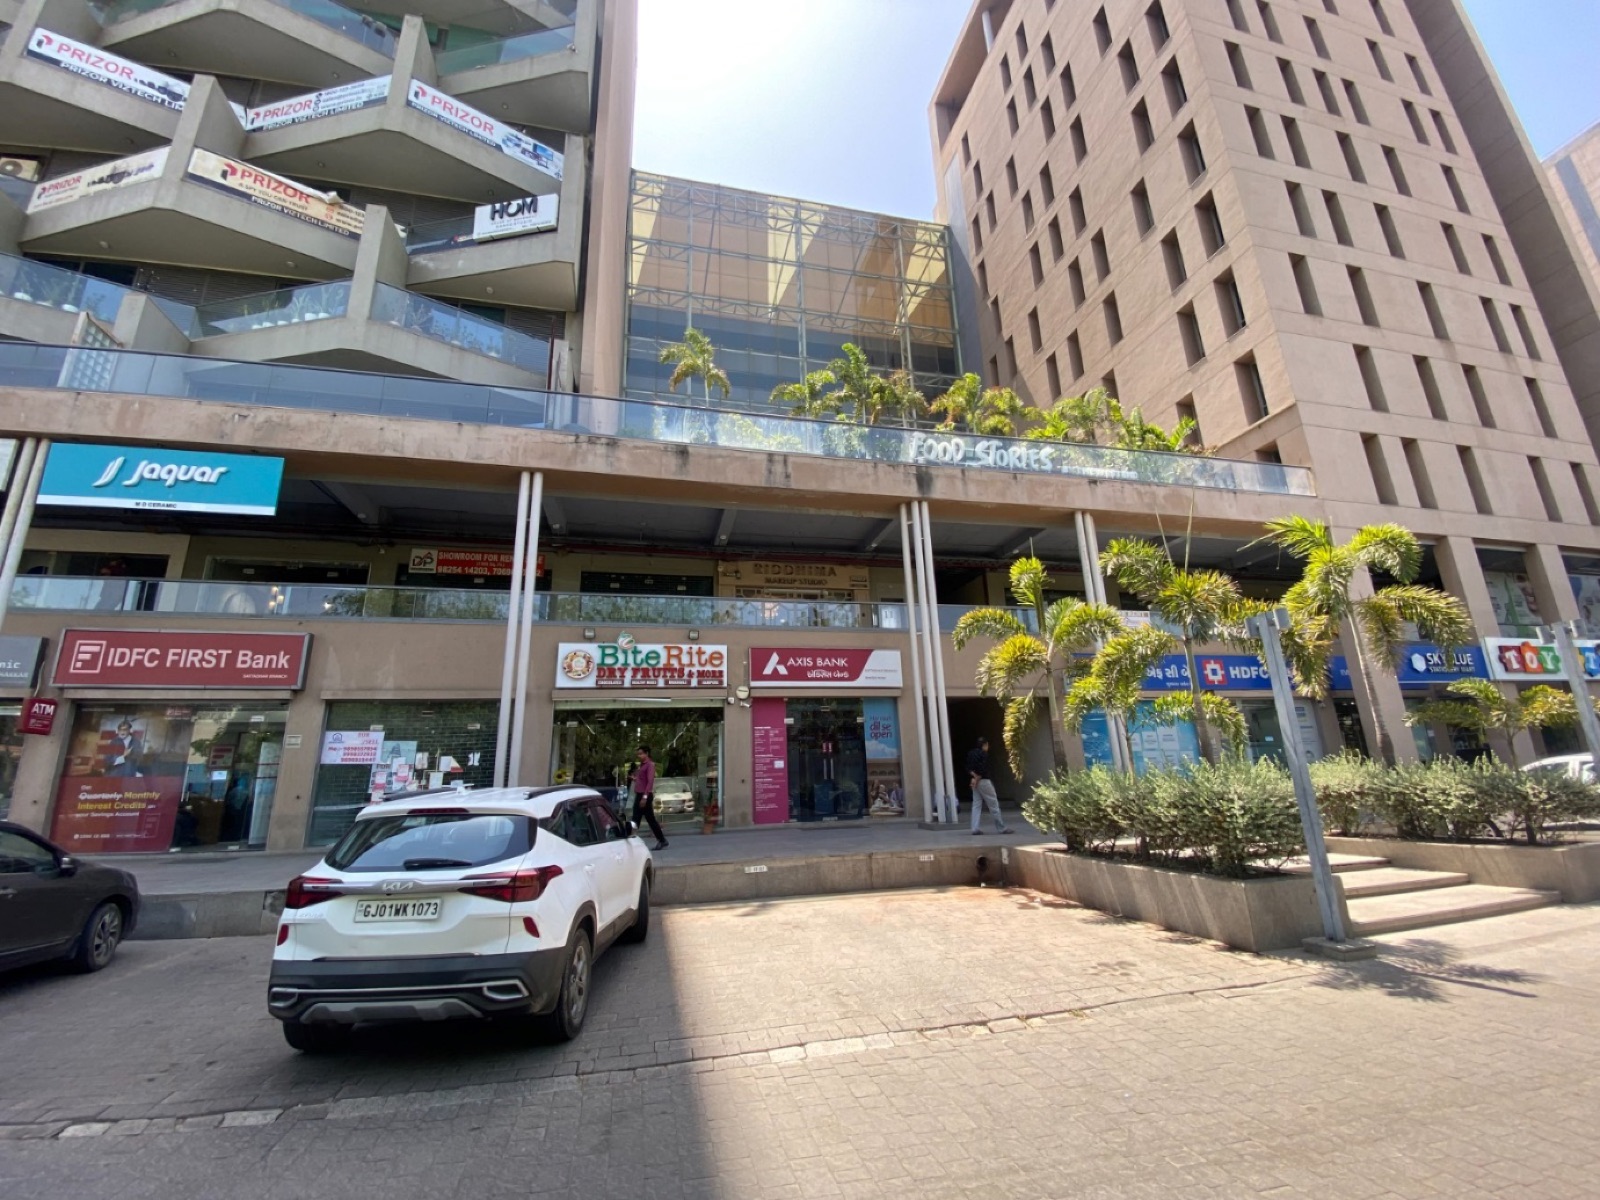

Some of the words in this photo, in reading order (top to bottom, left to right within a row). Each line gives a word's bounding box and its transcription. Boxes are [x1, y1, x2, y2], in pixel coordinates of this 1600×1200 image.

[57, 43, 134, 80] PRIZOR
[60, 62, 108, 84] PRIZOR
[110, 78, 162, 104] VIZTECH
[262, 99, 313, 122] PRIZOR
[431, 95, 495, 136] PRIZOR
[240, 169, 310, 204] PRIZOR
[122, 460, 230, 487] Jaquar
[438, 552, 482, 561] SHOWROOM
[483, 554, 498, 562] FOR
[107, 648, 160, 668] IDFC
[166, 648, 232, 668] FIRST
[236, 650, 291, 669] Bank
[786, 656, 814, 666] AXIS
[816, 658, 848, 668] BANK
[596, 667, 626, 678] DRY
[630, 667, 684, 678] FRUITS
[696, 670, 724, 678] MORE
[31, 702, 56, 716] ATM
[870, 732, 892, 740] open
[124, 792, 160, 800] Monthly
[78, 802, 112, 810] Interest
[114, 802, 146, 810] Credits
